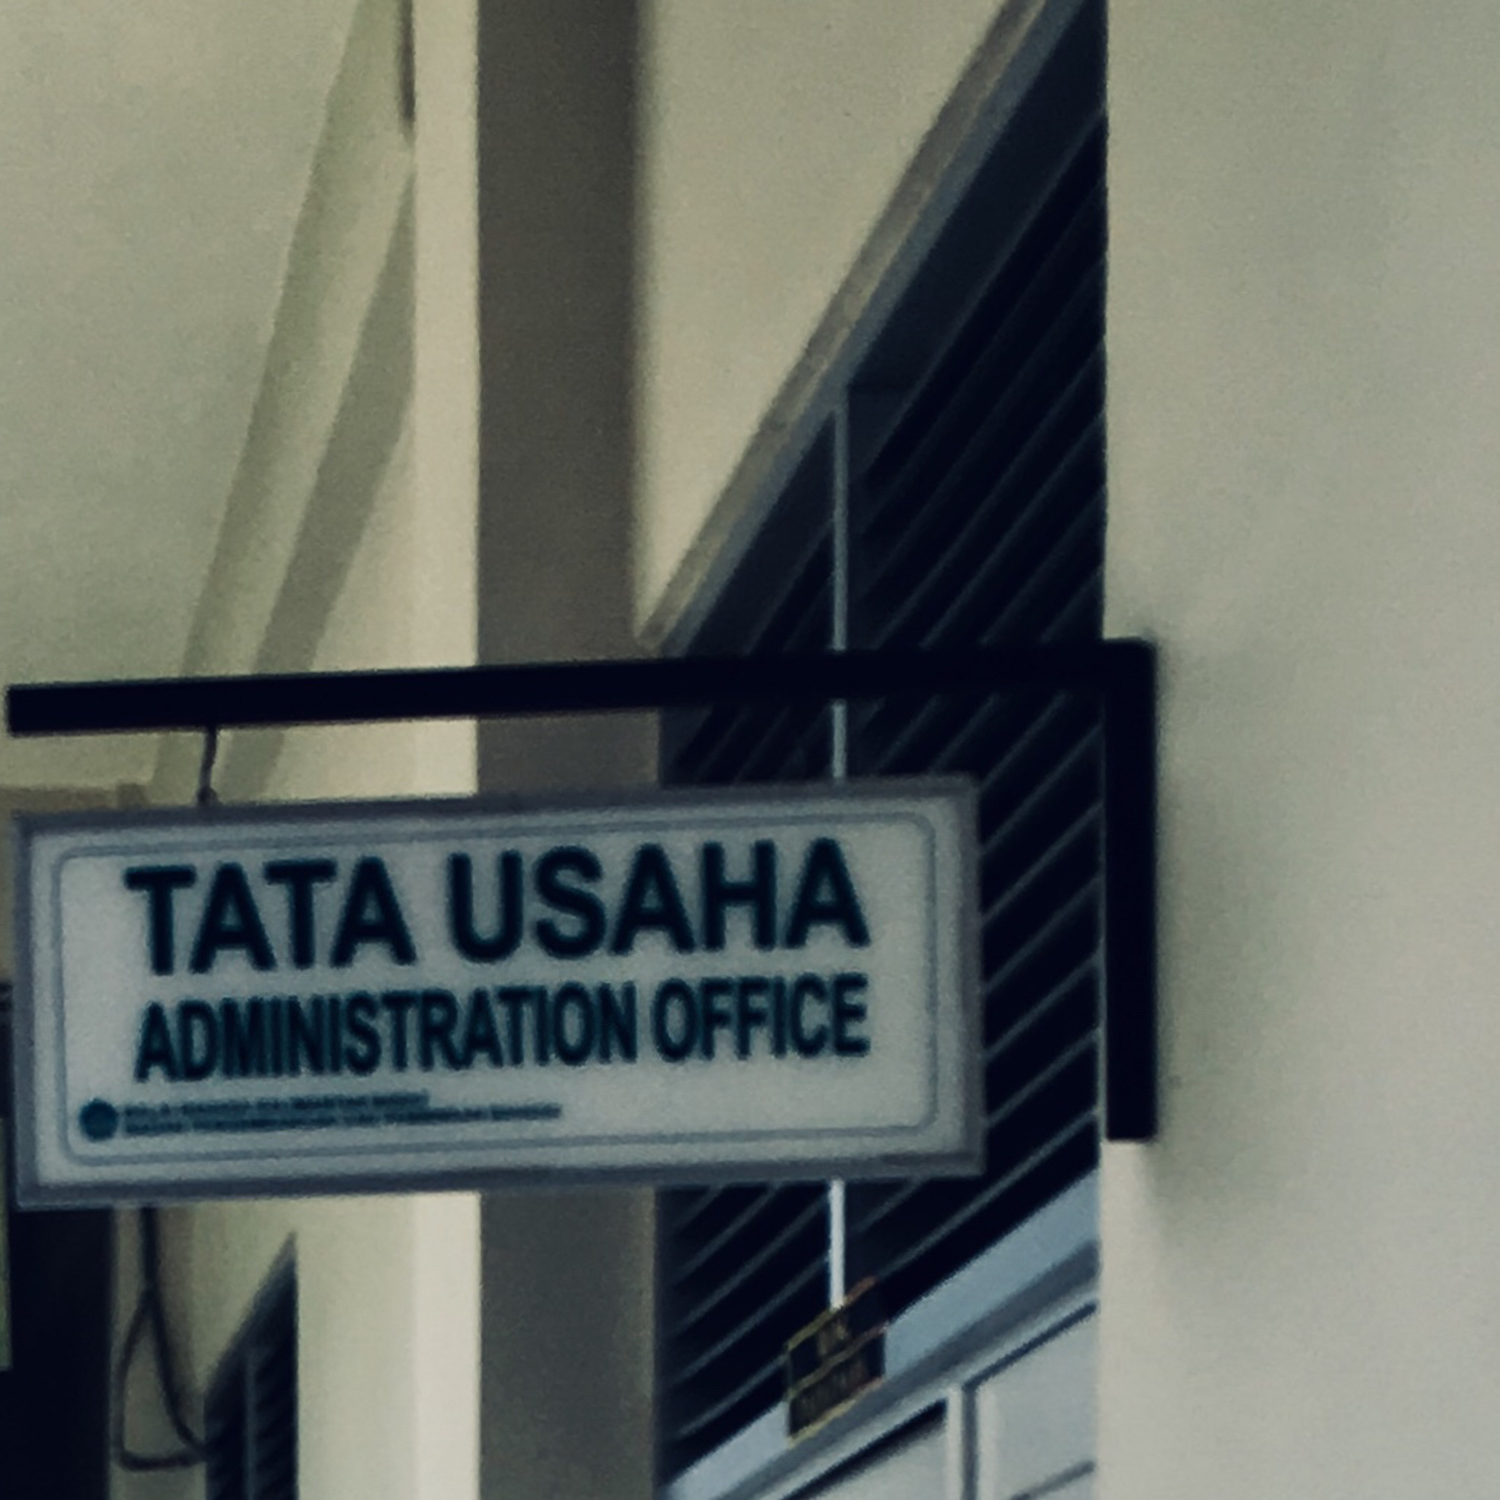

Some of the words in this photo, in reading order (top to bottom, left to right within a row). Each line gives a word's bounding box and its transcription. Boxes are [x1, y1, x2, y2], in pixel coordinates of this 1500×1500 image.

[124, 856, 418, 976] TATA
[445, 837, 871, 963] USAHA
[134, 981, 636, 1083] ADMINISTRATION
[654, 973, 870, 1063] OFFICE
